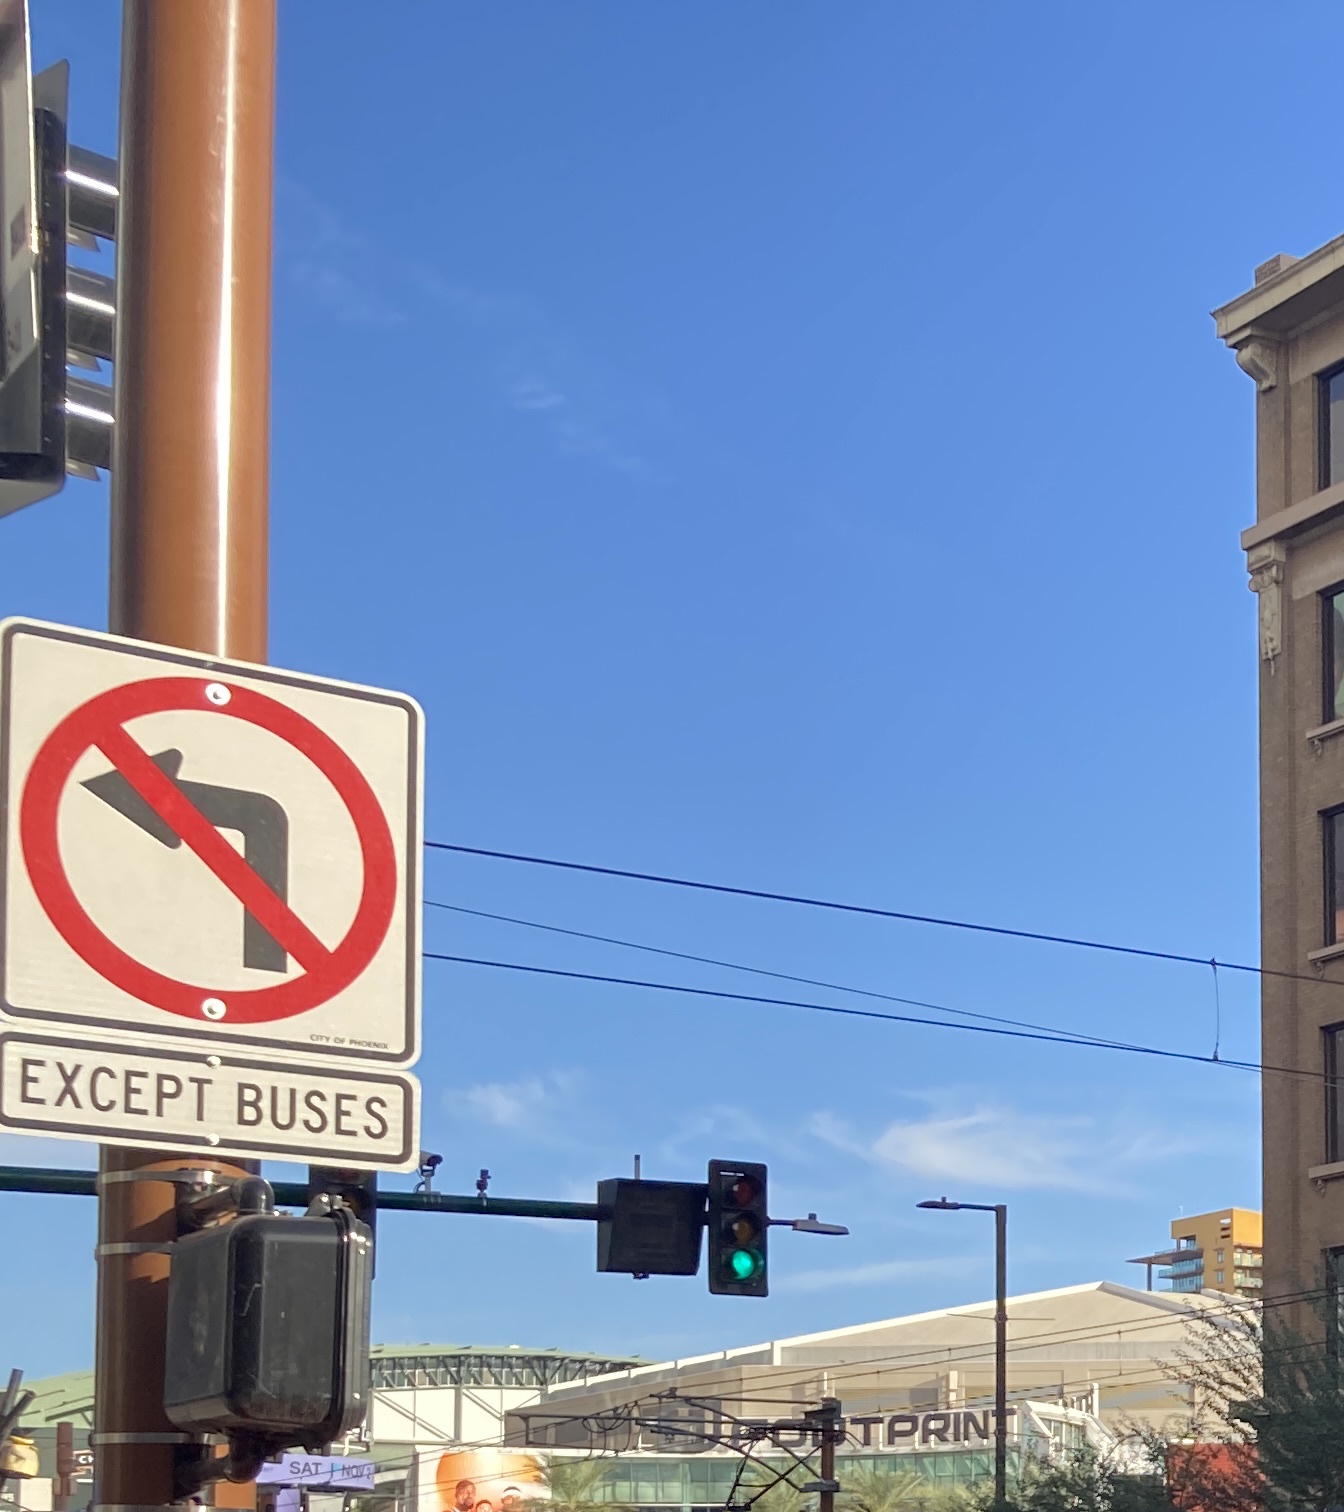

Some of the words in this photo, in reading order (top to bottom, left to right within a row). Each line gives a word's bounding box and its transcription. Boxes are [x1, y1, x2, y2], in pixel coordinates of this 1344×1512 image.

[309, 1033, 330, 1043] CITY
[334, 1036, 346, 1045] OF
[349, 1038, 389, 1050] PHOENIX
[20, 1057, 213, 1122] EXCEPT
[236, 1081, 389, 1140] BUSES
[289, 1461, 322, 1476] SAT
